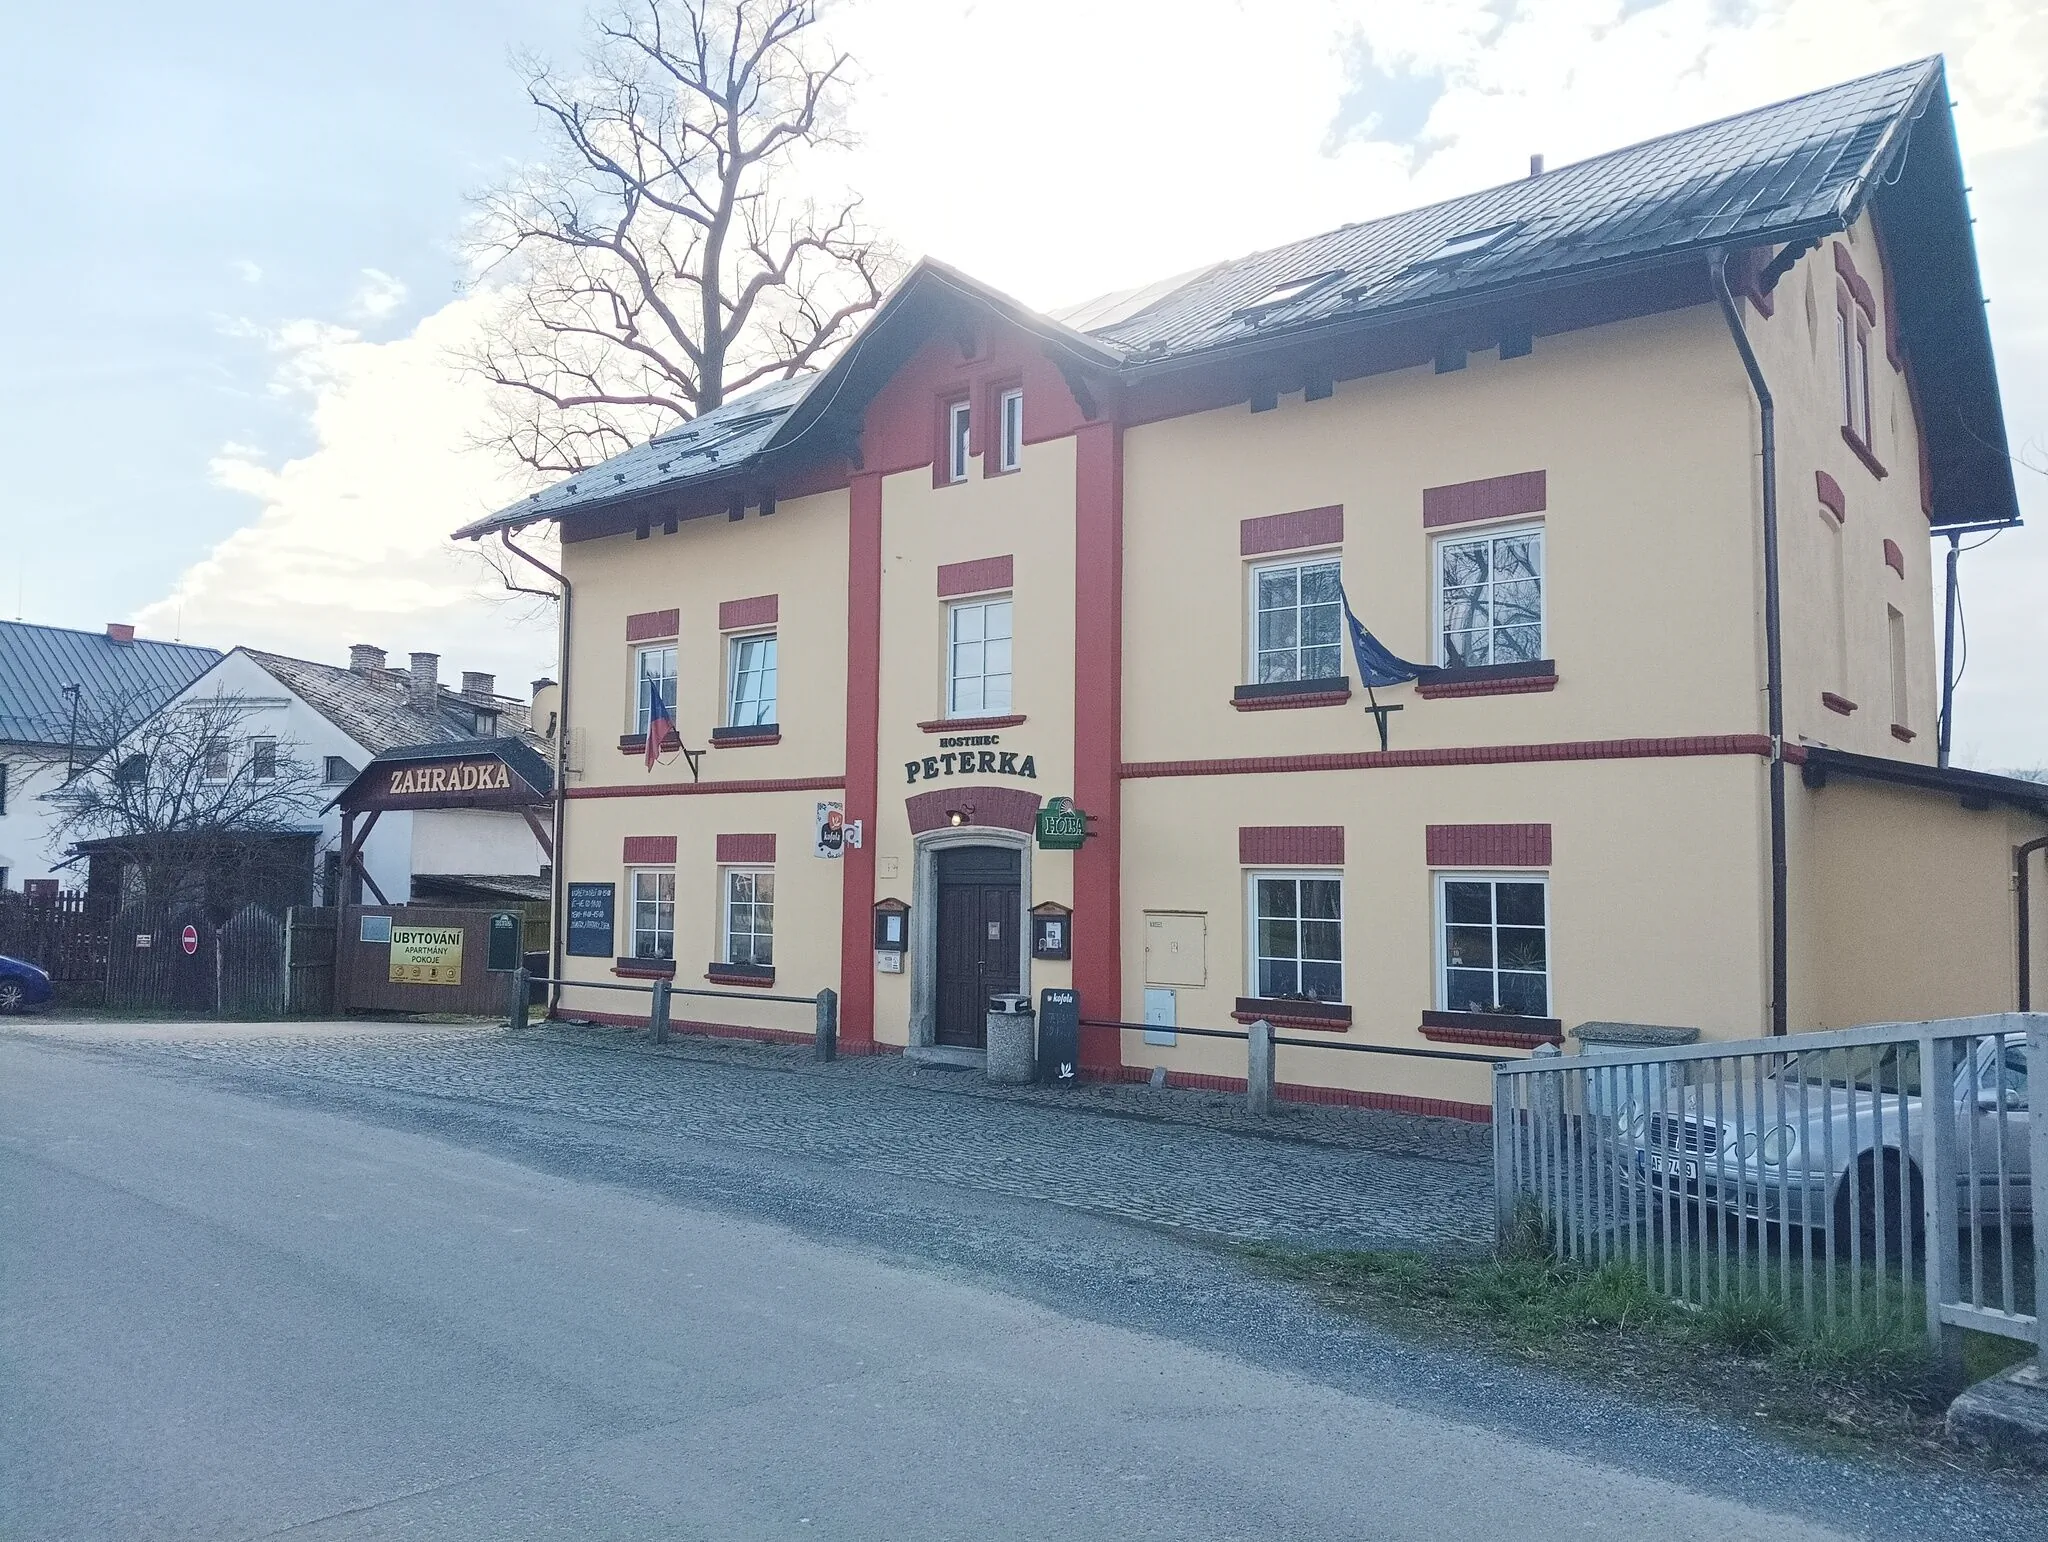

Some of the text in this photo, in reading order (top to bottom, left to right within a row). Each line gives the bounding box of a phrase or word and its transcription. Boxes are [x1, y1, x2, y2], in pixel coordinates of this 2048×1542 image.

[939, 735, 1000, 749] HOSTINEC
[904, 750, 1038, 785] PETERKA
[389, 761, 511, 794] ZAHRÁDKA
[1045, 816, 1084, 836] HOLBA
[393, 930, 463, 946] UBYTOVÁNÍ
[404, 945, 449, 955] APARTMÁNY
[411, 956, 441, 964] POKOJE
[1668, 1160, 1692, 1177] 749
